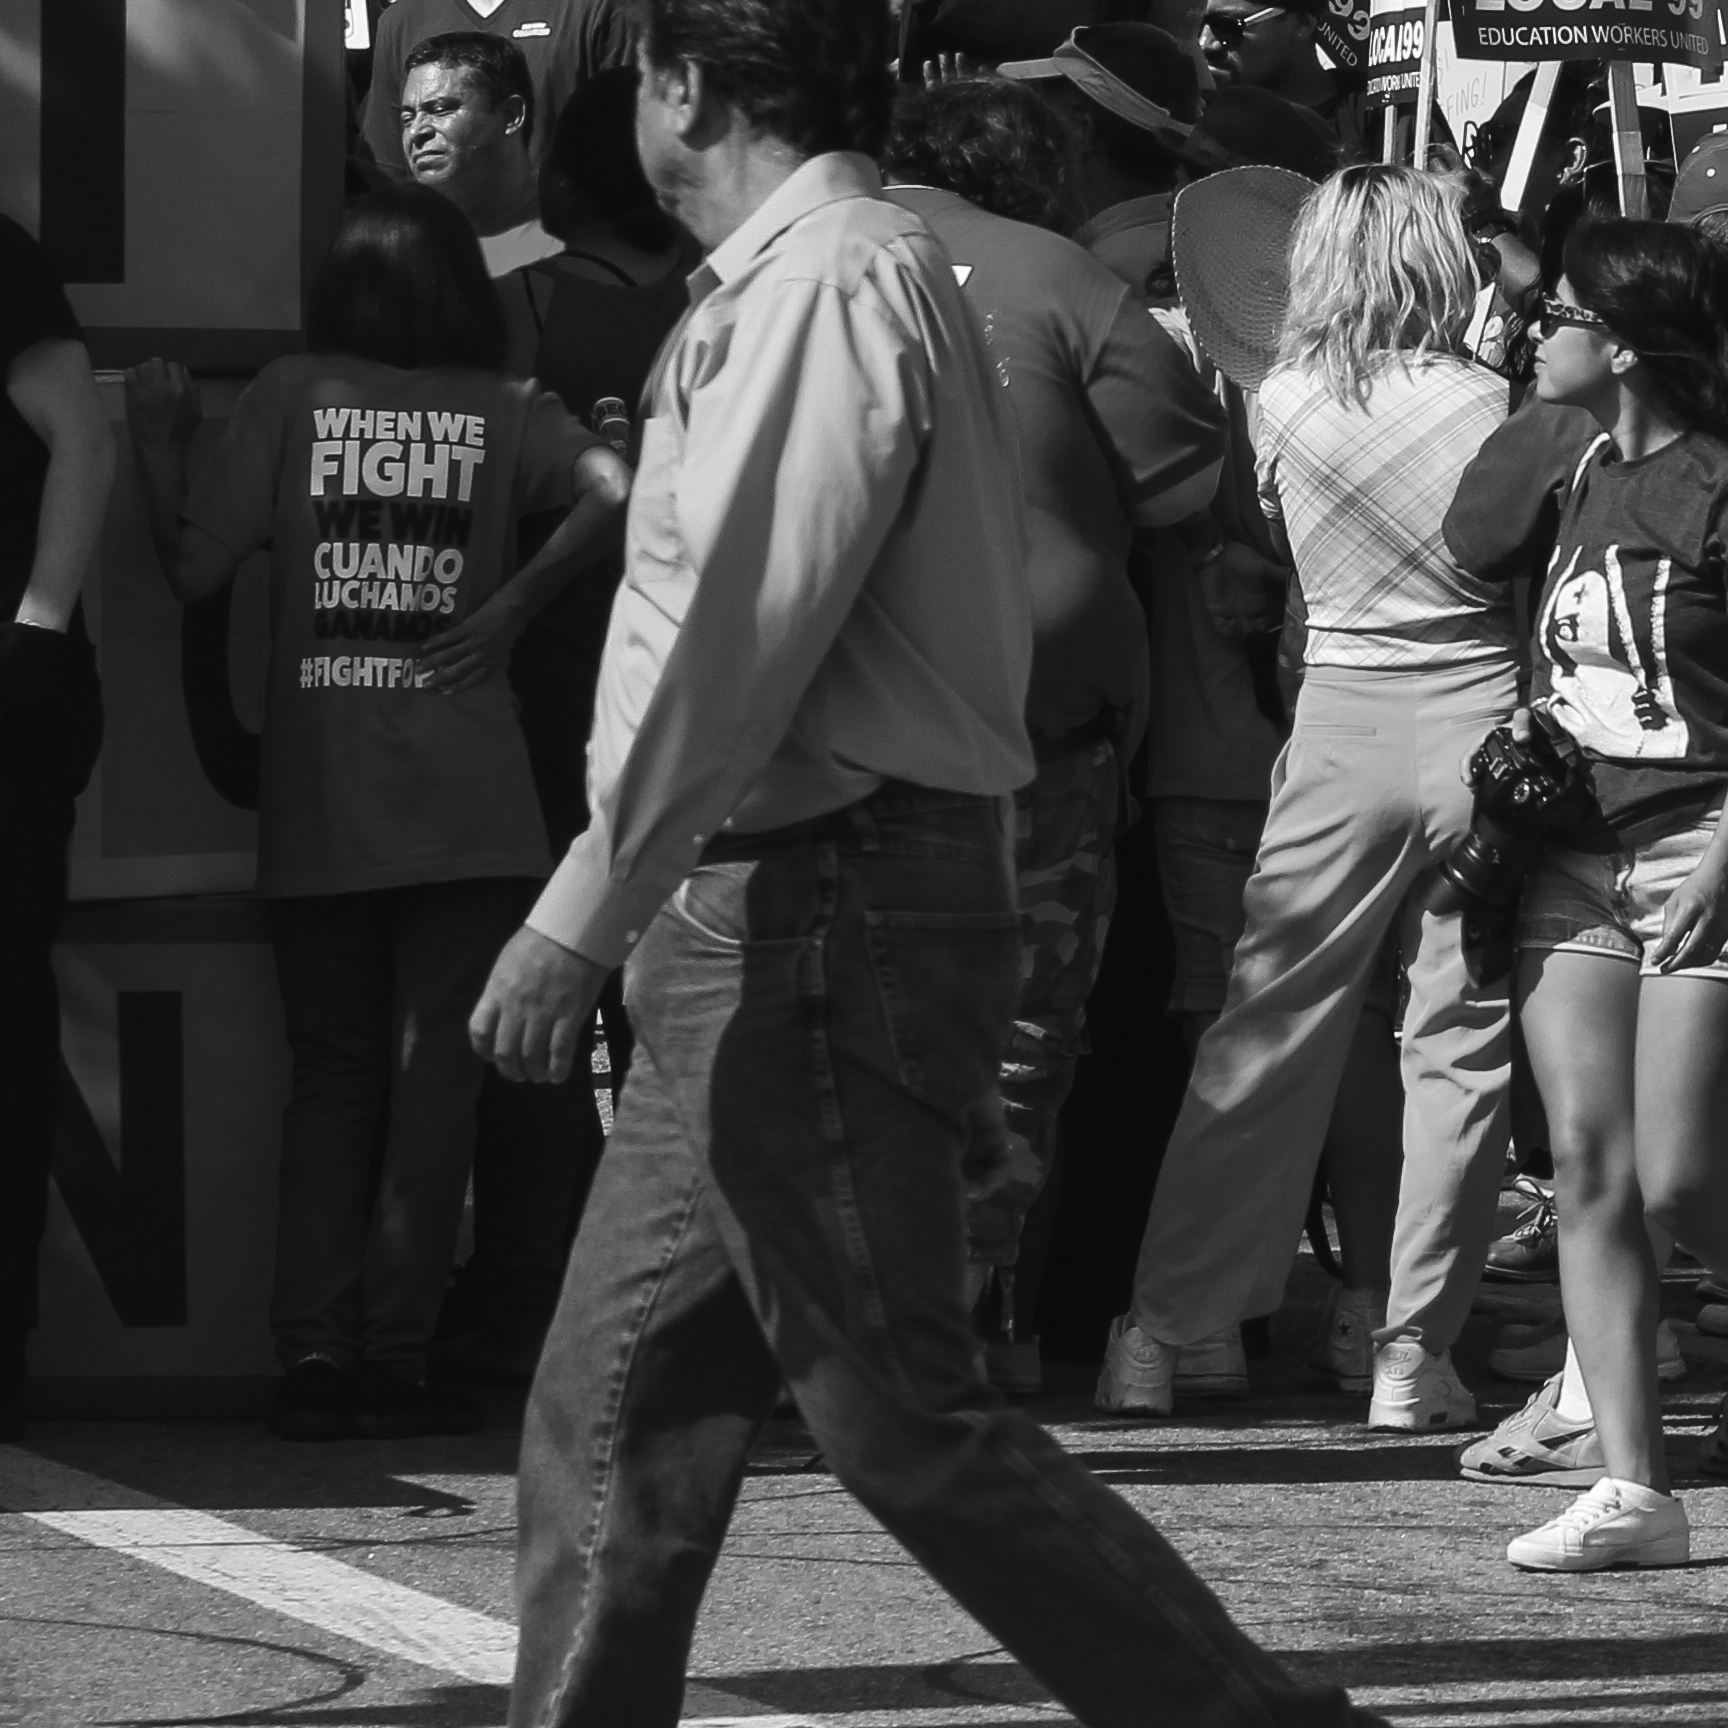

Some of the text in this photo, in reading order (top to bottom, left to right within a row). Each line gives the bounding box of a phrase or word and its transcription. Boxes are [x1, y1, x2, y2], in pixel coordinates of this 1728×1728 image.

[1478, 25, 1709, 55] EDUCATION WORKERS UNITED
[313, 408, 485, 446] WHEN WE
[310, 440, 486, 502] FIGHT
[313, 500, 474, 547] WE WIN
[314, 542, 464, 584] CUANDO
[314, 580, 458, 614] LUCHAMOS
